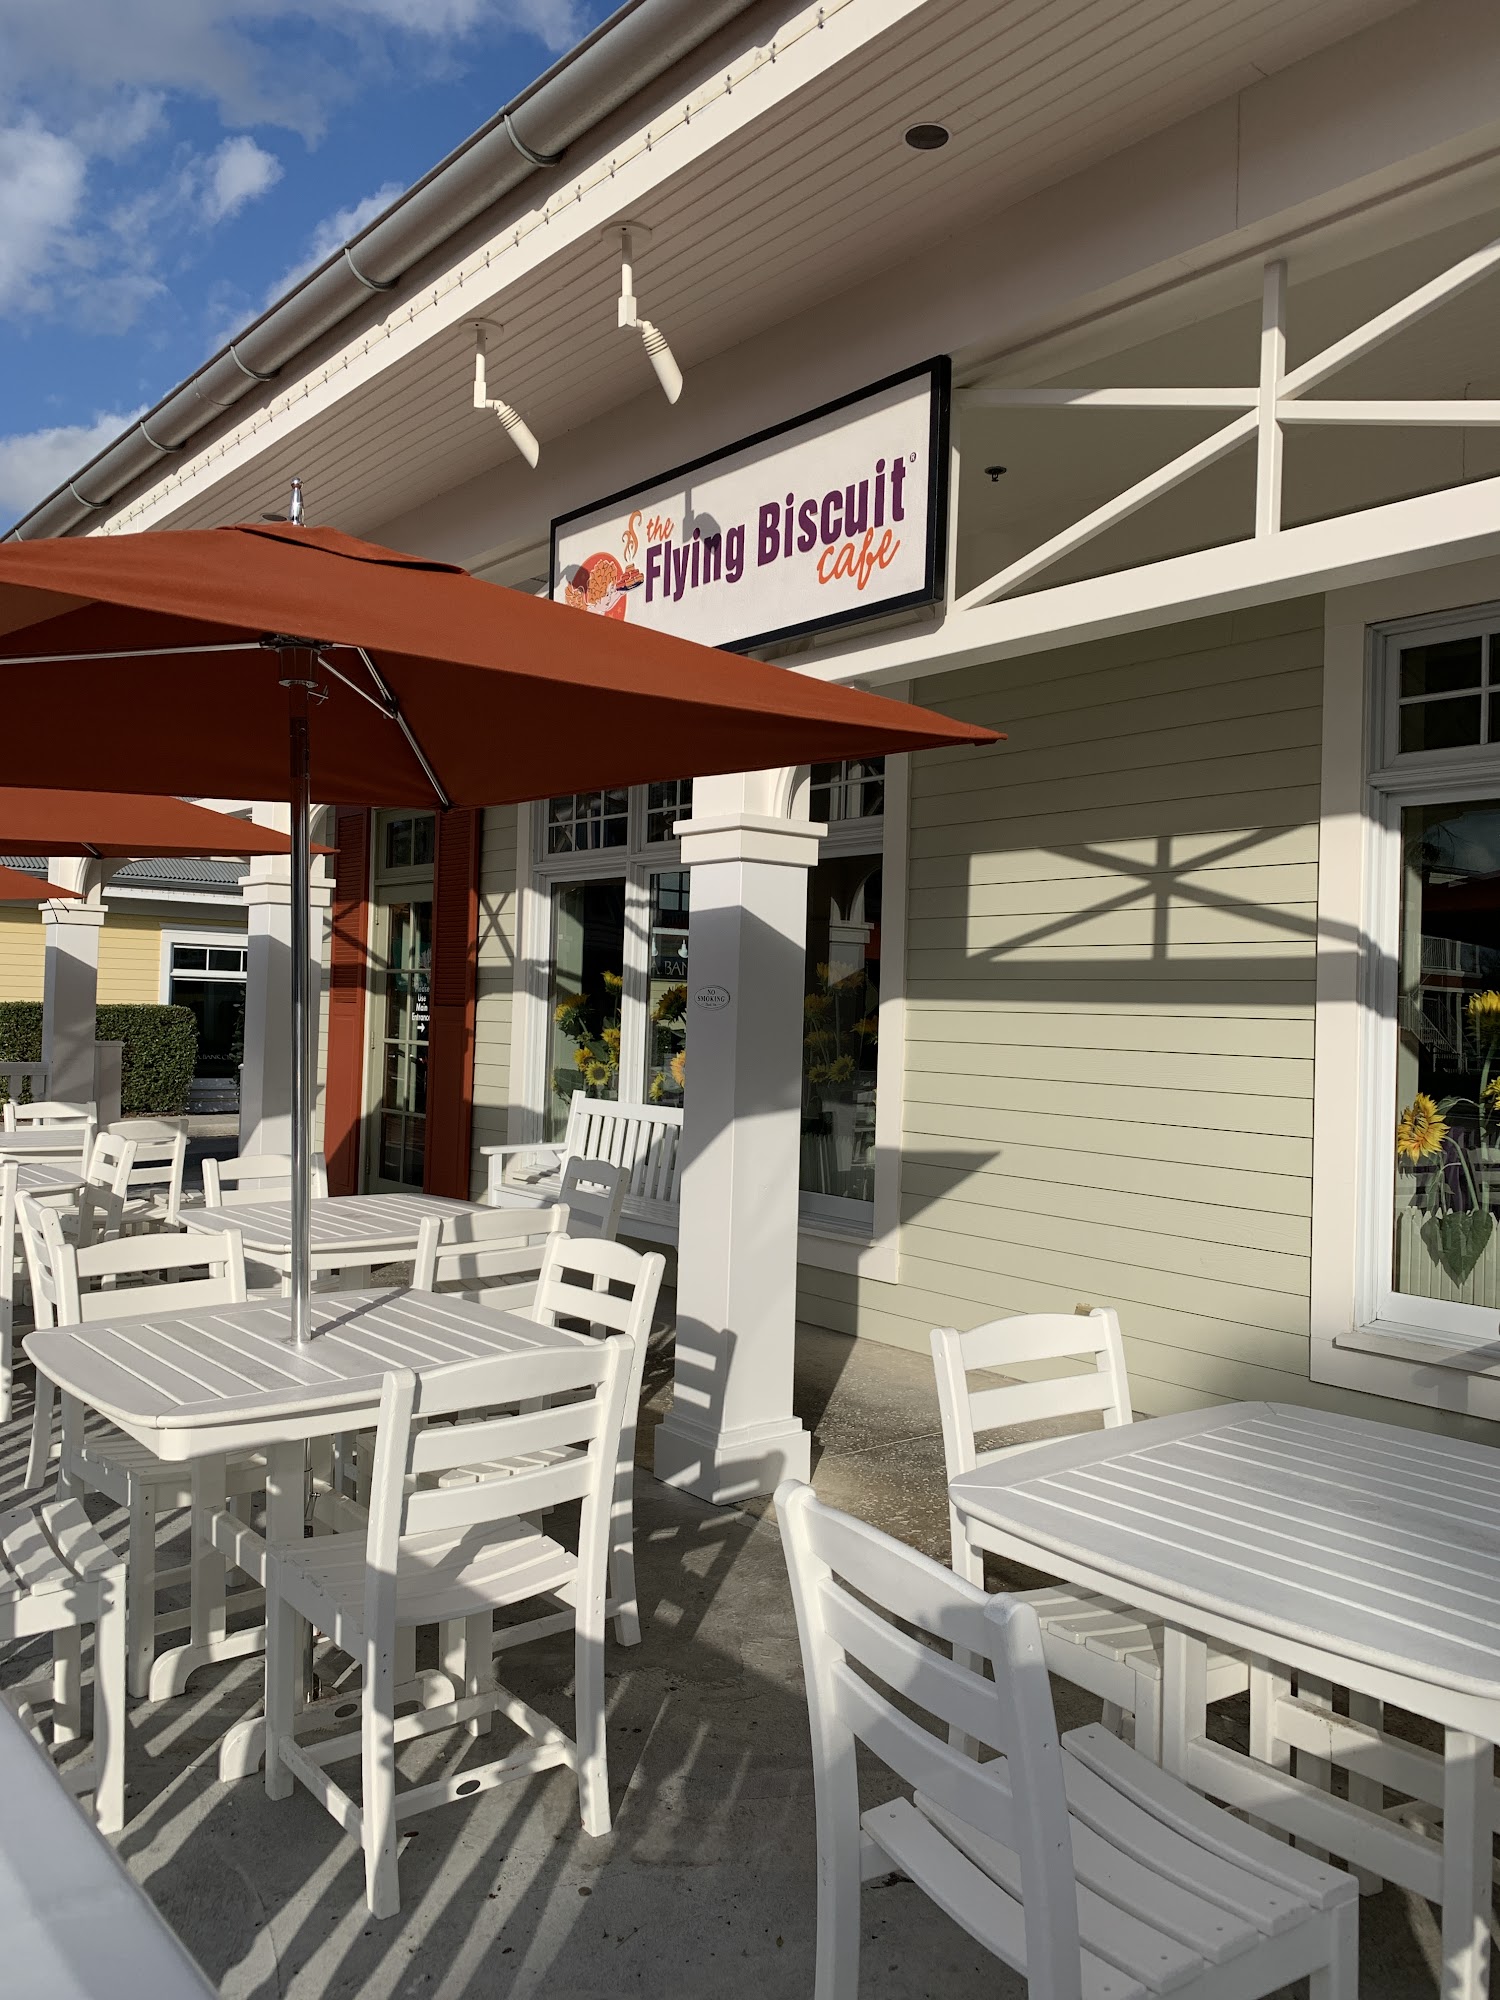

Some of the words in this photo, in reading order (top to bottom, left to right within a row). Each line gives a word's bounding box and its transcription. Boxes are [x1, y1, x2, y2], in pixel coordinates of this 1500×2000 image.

[645, 524, 746, 603] Flying
[757, 457, 906, 567] Biscuit
[646, 515, 675, 543] the
[816, 526, 901, 591] cafe
[664, 960, 688, 976] BAN
[417, 993, 427, 1002] Use
[415, 1002, 428, 1012] Main
[411, 1012, 430, 1021] Entranc
